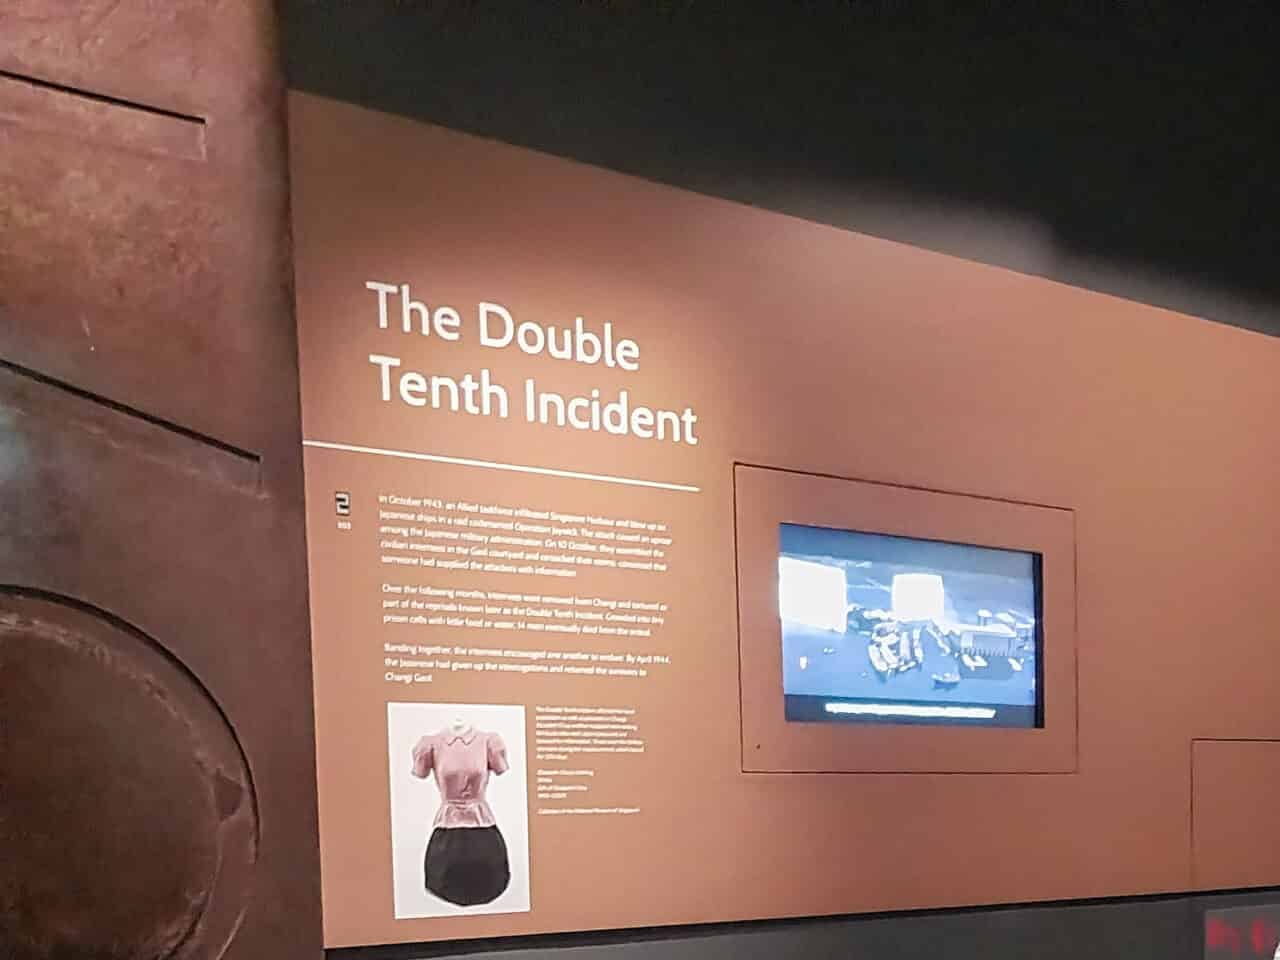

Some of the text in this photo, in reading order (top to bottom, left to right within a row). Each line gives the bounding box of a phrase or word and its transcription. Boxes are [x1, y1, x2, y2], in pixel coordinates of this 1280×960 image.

[365, 281, 639, 370] The Double
[369, 354, 697, 445] Tenth Incident
